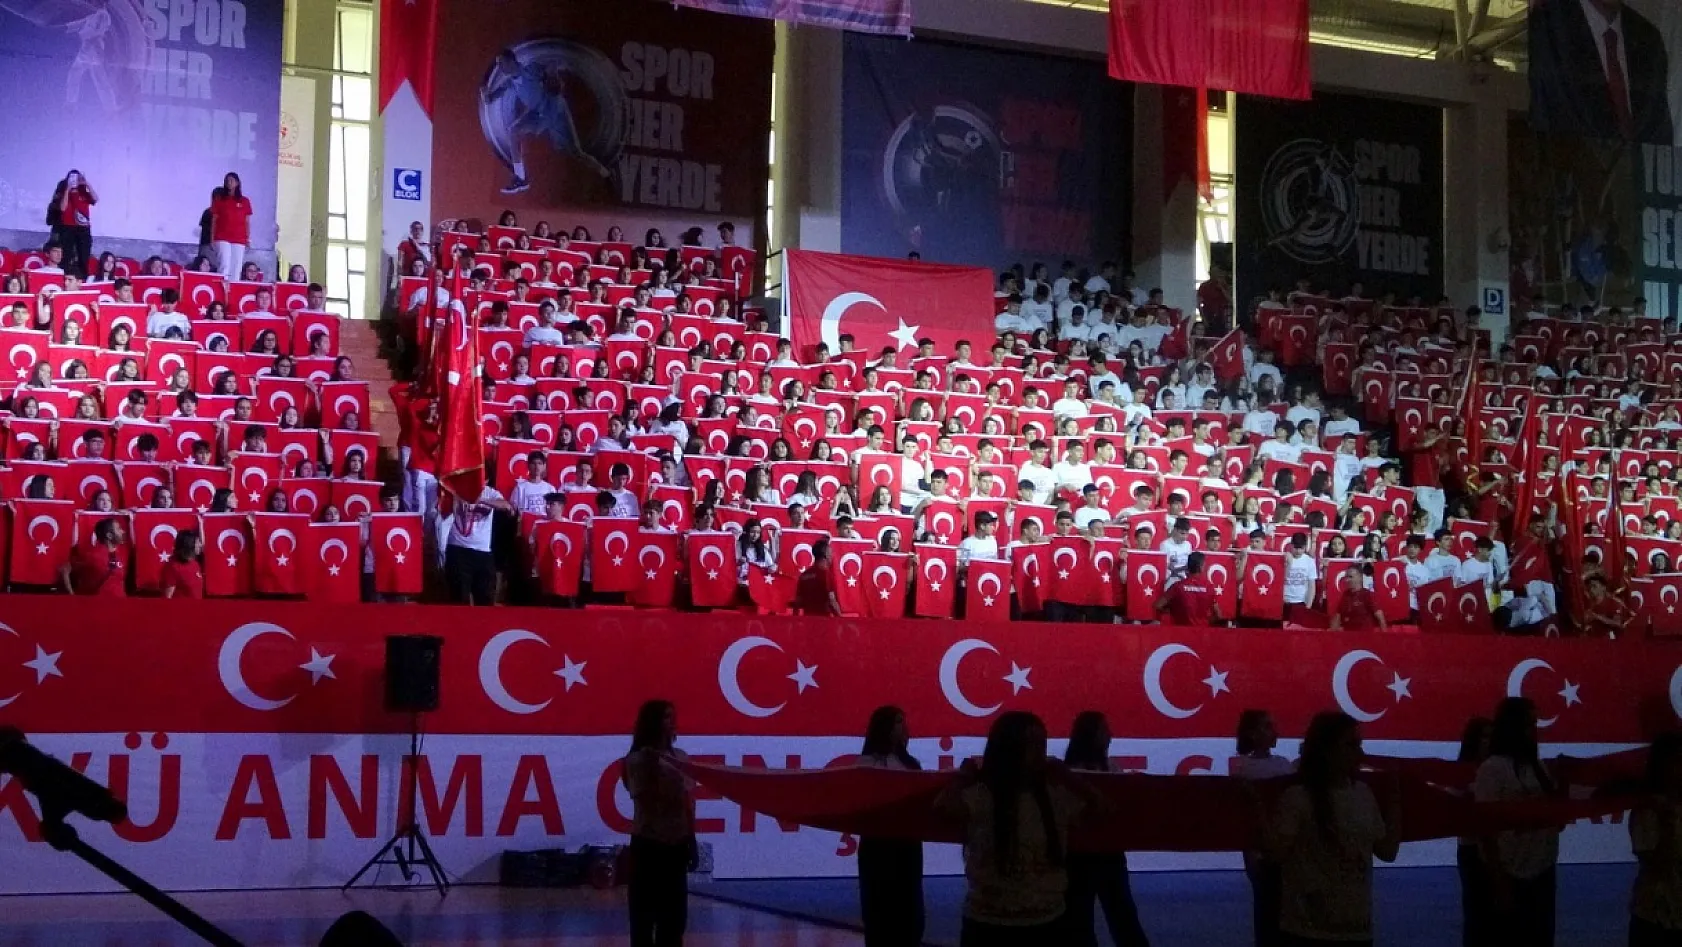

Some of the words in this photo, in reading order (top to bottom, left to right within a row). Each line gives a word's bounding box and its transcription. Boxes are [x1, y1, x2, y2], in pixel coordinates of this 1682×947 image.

[143, 0, 246, 48] SPOR
[140, 47, 213, 99] HER
[621, 41, 714, 100] SPOR
[621, 98, 684, 152] HER
[397, 170, 417, 191] C
[619, 153, 722, 212] YERDE
[1355, 138, 1421, 184] SPOR
[394, 190, 420, 199] BLOK
[1356, 229, 1429, 275] YERDE
[1486, 289, 1501, 306] D
[215, 754, 566, 840] ANMA
